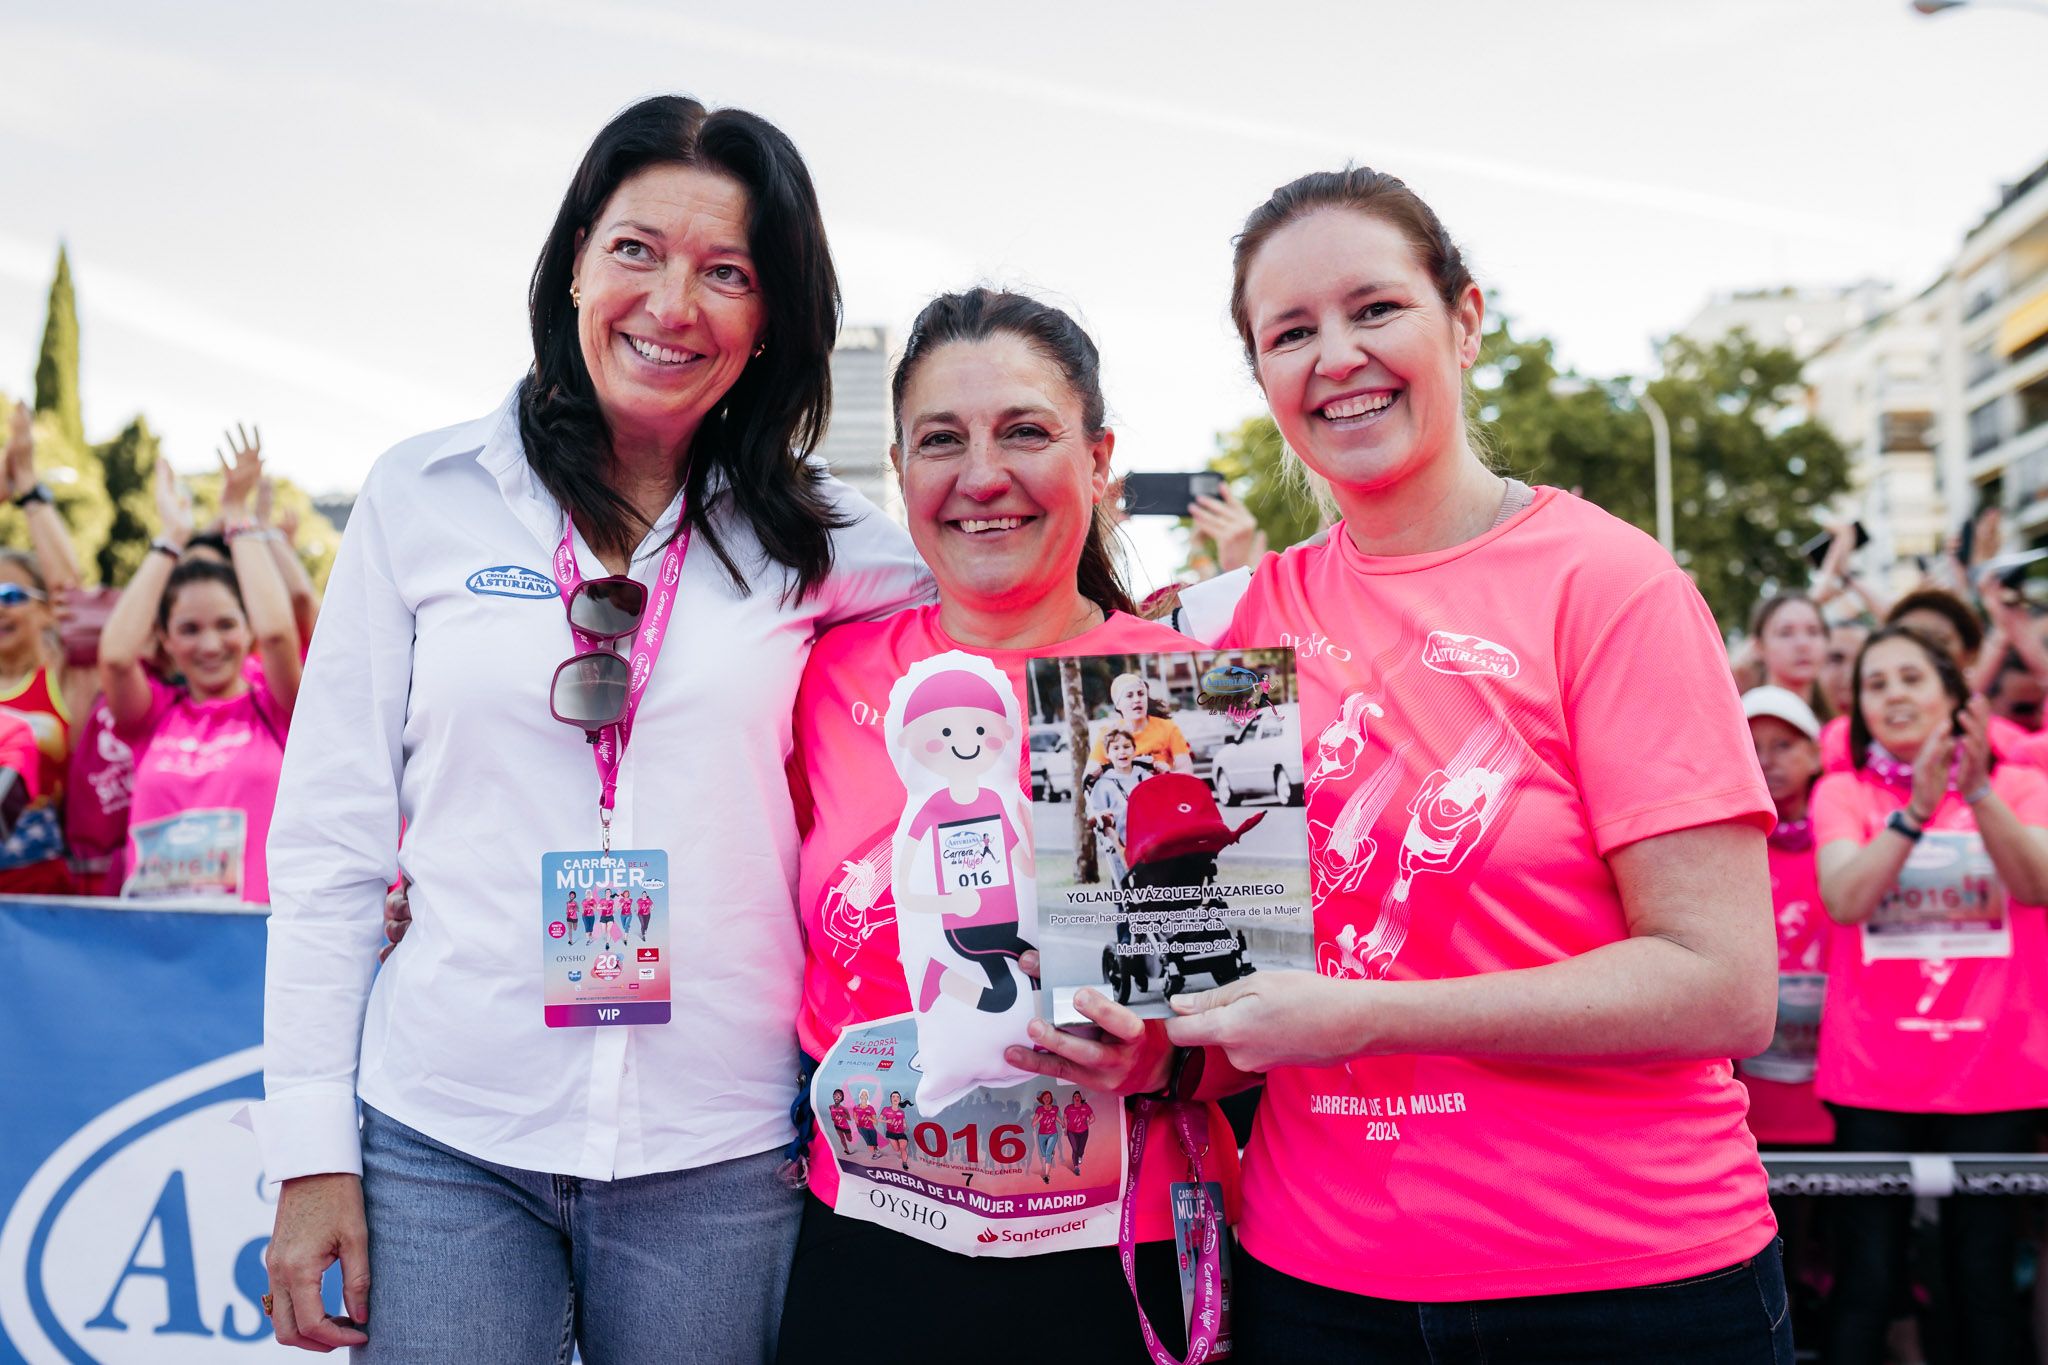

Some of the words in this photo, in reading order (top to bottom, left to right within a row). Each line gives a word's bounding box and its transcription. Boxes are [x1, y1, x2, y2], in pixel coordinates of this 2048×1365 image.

[474, 574, 553, 594] ASTURIANA
[643, 624, 659, 648] Mujer
[1428, 642, 1509, 675] ASTURIANA
[1226, 702, 1261, 726] Mujer
[563, 857, 627, 870] CARRERA
[943, 849, 974, 859] Carrera
[962, 855, 983, 870] Mujer
[556, 868, 645, 889] MUJER
[959, 870, 992, 887] 016
[1067, 890, 1133, 903] YOLANDA
[1135, 885, 1200, 900] VÁZQUEZ
[1203, 884, 1284, 898] MAZARIEGO
[1051, 915, 1067, 924] Por
[1070, 915, 1097, 924] crear,
[1099, 913, 1127, 923] hacer
[1130, 912, 1158, 921] crecer
[1160, 913, 1167, 923] y
[1170, 909, 1197, 920] sentir
[1199, 909, 1208, 918] la
[1210, 909, 1246, 918] Carrera
[1249, 907, 1261, 916] de
[1263, 906, 1272, 915] la
[1274, 905, 1301, 916] Mujer
[1130, 922, 1160, 933] desde
[1162, 921, 1171, 931] el
[1173, 921, 1205, 933] primer
[1118, 944, 1155, 954] Madrid,
[1157, 943, 1169, 952] 12
[1171, 942, 1182, 951] de
[1186, 942, 1212, 953] mayo
[1214, 940, 1239, 950] 2024
[556, 954, 586, 963] OYSHO
[596, 954, 618, 970] 20
[598, 1009, 621, 1021] VIP
[849, 1045, 896, 1056] SUMA
[867, 1036, 898, 1047] DORSAL
[1310, 1094, 1369, 1116] CARRERA
[1369, 1097, 1383, 1116] DE
[1386, 1096, 1407, 1116] LA
[1410, 1092, 1467, 1114] MUJER
[1366, 1121, 1401, 1141] 2024
[912, 1121, 1027, 1164] 016
[962, 1172, 973, 1187] 7
[866, 1169, 925, 1191] CARRERA
[928, 1184, 945, 1200] DE
[948, 1188, 966, 1204] LA
[968, 1194, 1014, 1213] MUJER
[1027, 1193, 1087, 1211] MADRID
[869, 1188, 948, 1231] OYSHO
[1177, 1200, 1205, 1219] MUJE
[1001, 1218, 1089, 1243] Santander
[1204, 1262, 1213, 1296] Carrera
[1199, 1307, 1215, 1331] Mujer
